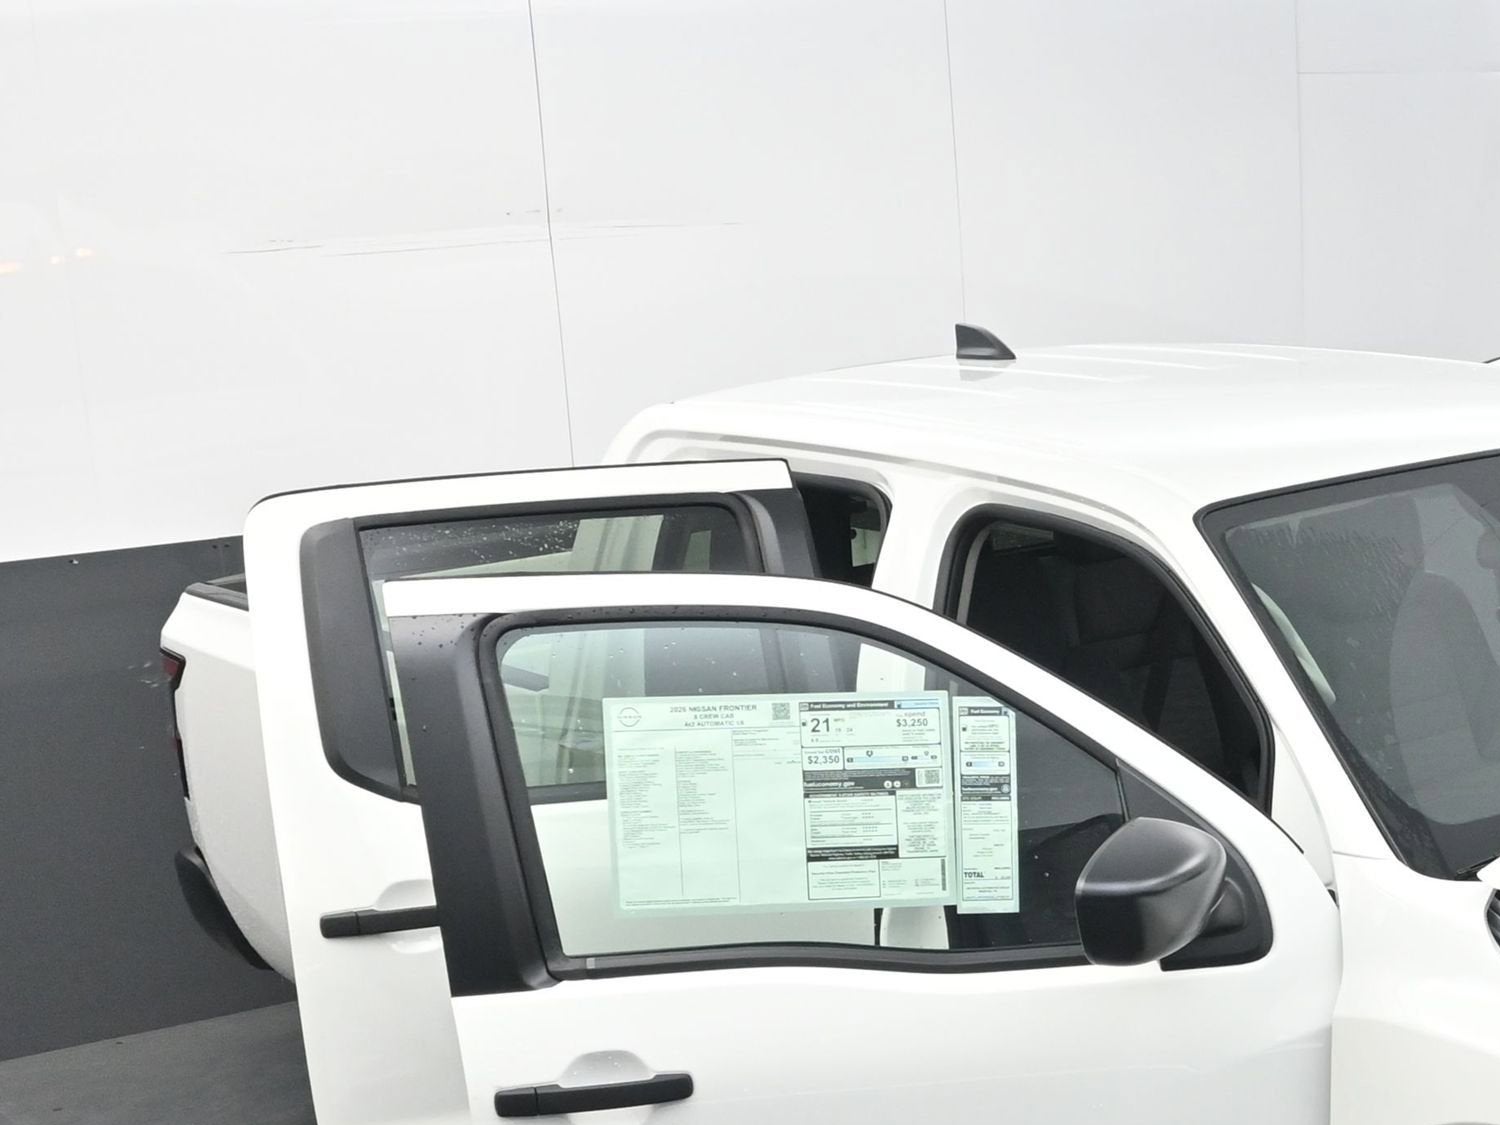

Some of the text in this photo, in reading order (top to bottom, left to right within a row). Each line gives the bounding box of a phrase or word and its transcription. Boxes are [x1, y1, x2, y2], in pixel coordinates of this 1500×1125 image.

[688, 705, 718, 713] NISSAN
[718, 704, 758, 712] FRONTIER
[810, 718, 830, 733] 21
[896, 718, 929, 728] $3,250
[807, 755, 840, 765] $2,350
